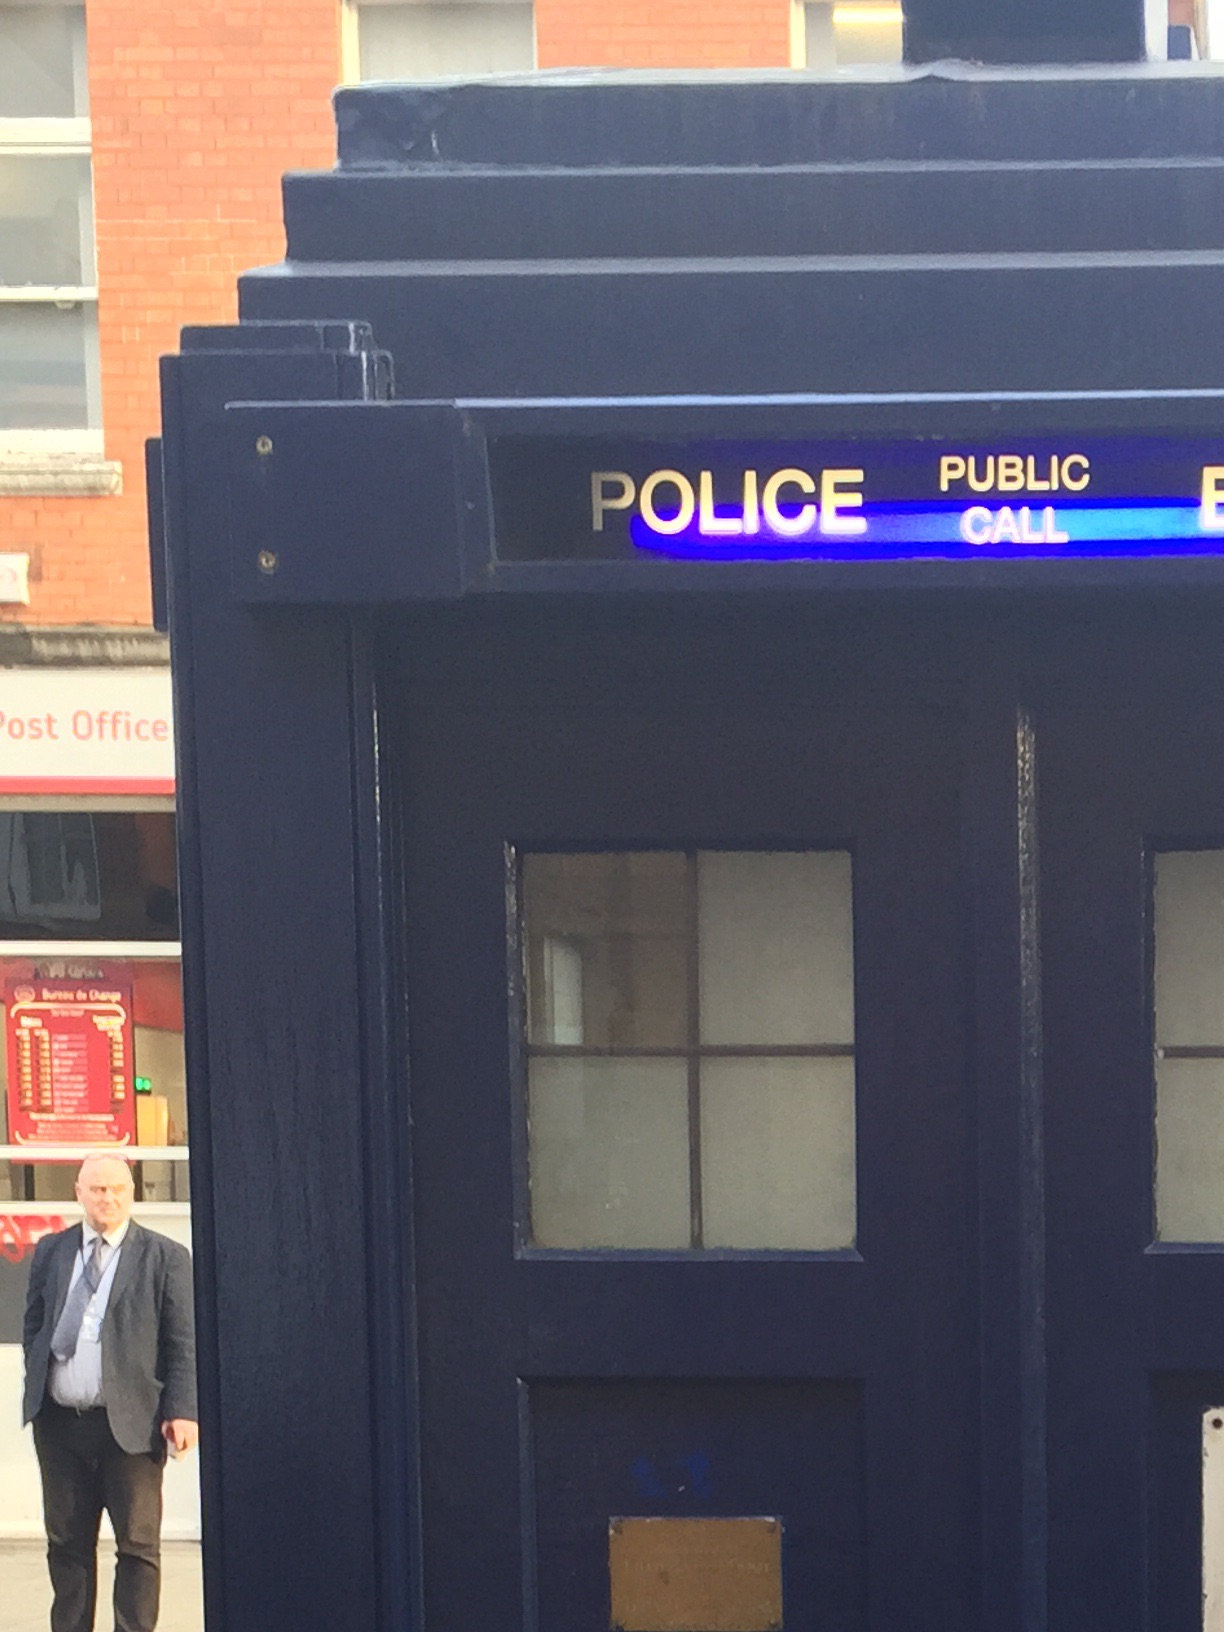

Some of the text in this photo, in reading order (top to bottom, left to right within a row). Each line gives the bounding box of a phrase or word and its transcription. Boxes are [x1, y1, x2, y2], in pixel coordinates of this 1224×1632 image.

[939, 454, 1091, 492] PUBLIC
[590, 467, 867, 536] POLICE
[960, 506, 1069, 545] CALL
[0, 709, 169, 742] ost Office
